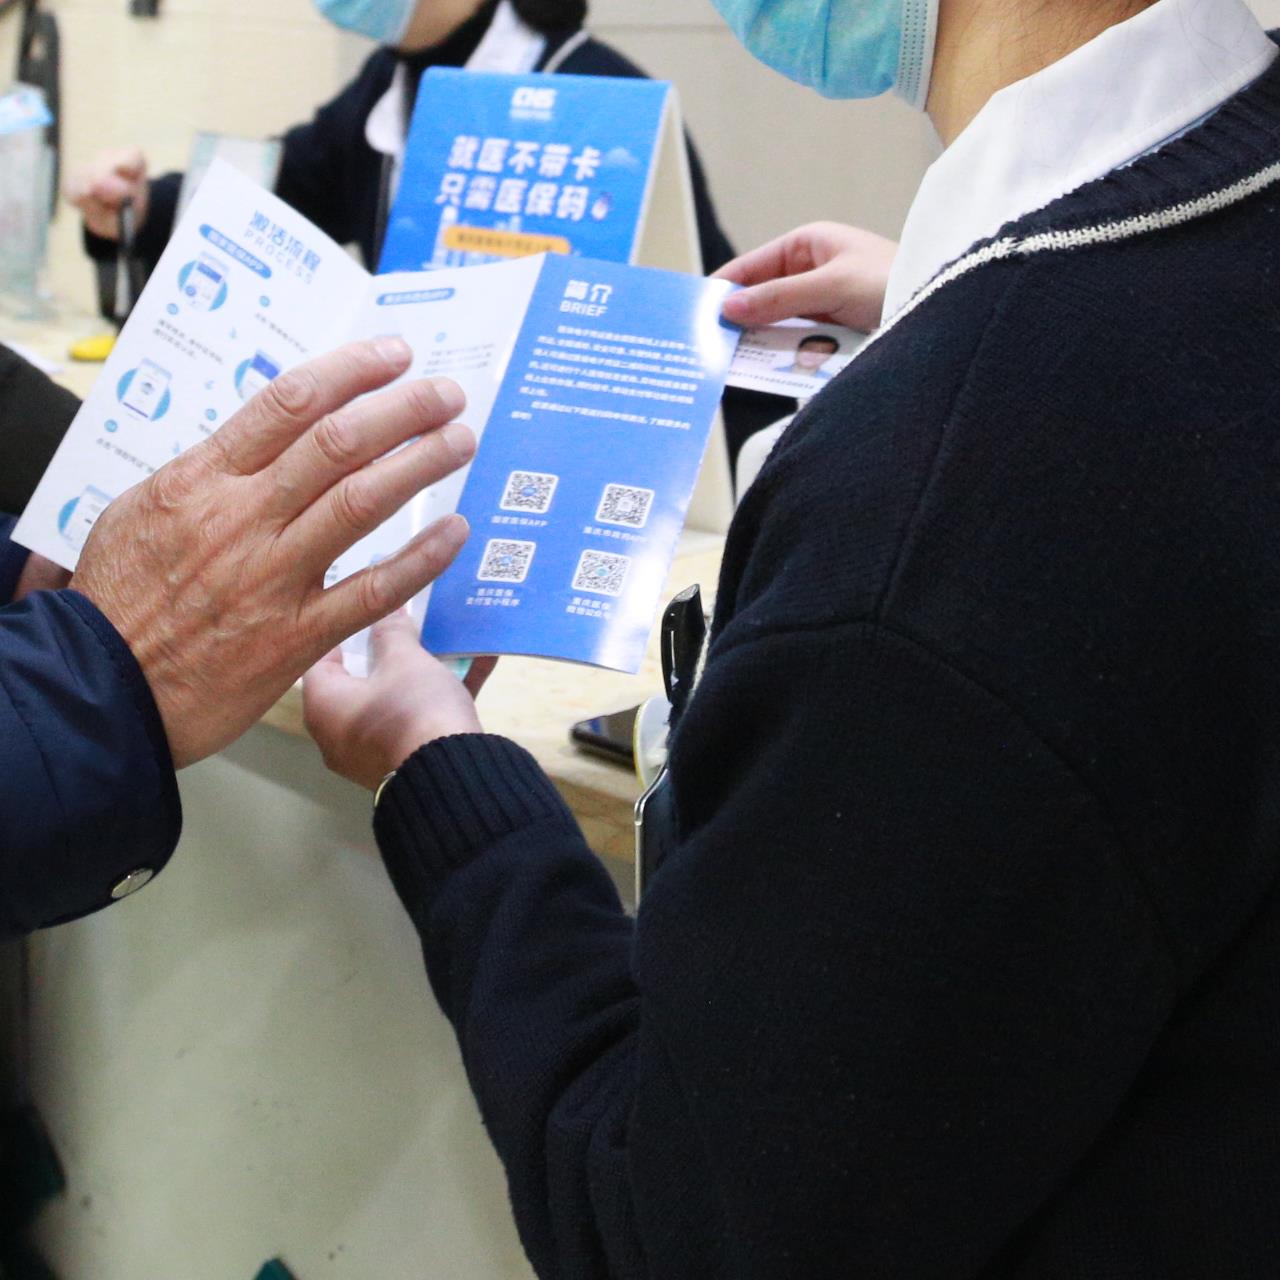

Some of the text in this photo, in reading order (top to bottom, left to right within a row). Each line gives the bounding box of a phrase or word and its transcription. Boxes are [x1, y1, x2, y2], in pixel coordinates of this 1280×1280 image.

[447, 135, 602, 181] 就医不带卡
[434, 172, 590, 222] 只需医保码
[244, 228, 314, 285] PROCESS
[249, 209, 322, 272] 激活流程
[559, 299, 609, 318] BRIEF
[563, 279, 613, 305] 简介
